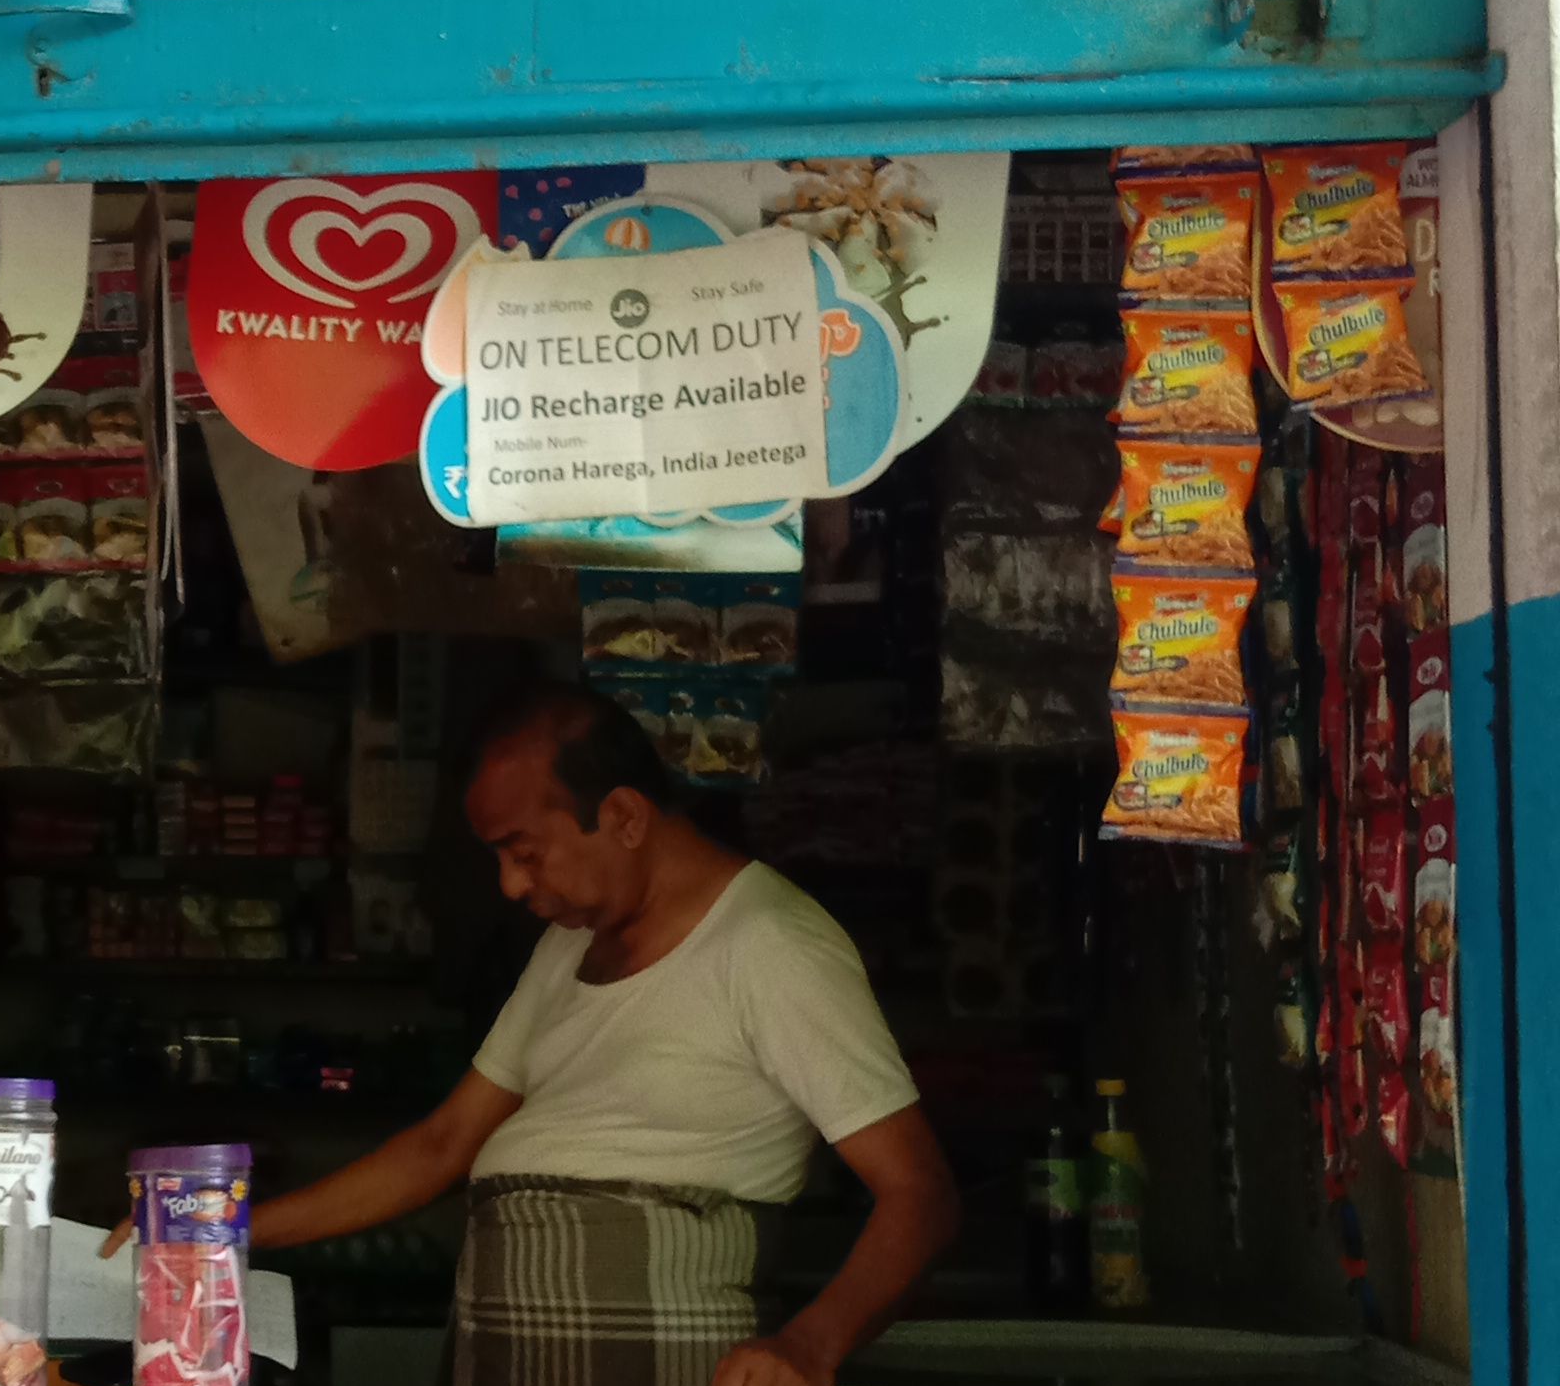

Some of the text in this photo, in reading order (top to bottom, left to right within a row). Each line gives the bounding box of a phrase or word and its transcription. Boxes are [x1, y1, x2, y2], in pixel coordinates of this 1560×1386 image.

[691, 277, 765, 303] Stay Safe
[216, 308, 364, 343] KWALITY
[479, 311, 803, 371] ON TELECOM DUTY
[481, 370, 806, 423] JIO Recharge Available
[493, 436, 543, 453] Mobile
[488, 443, 807, 486] Corona Harega, India Jeetega
